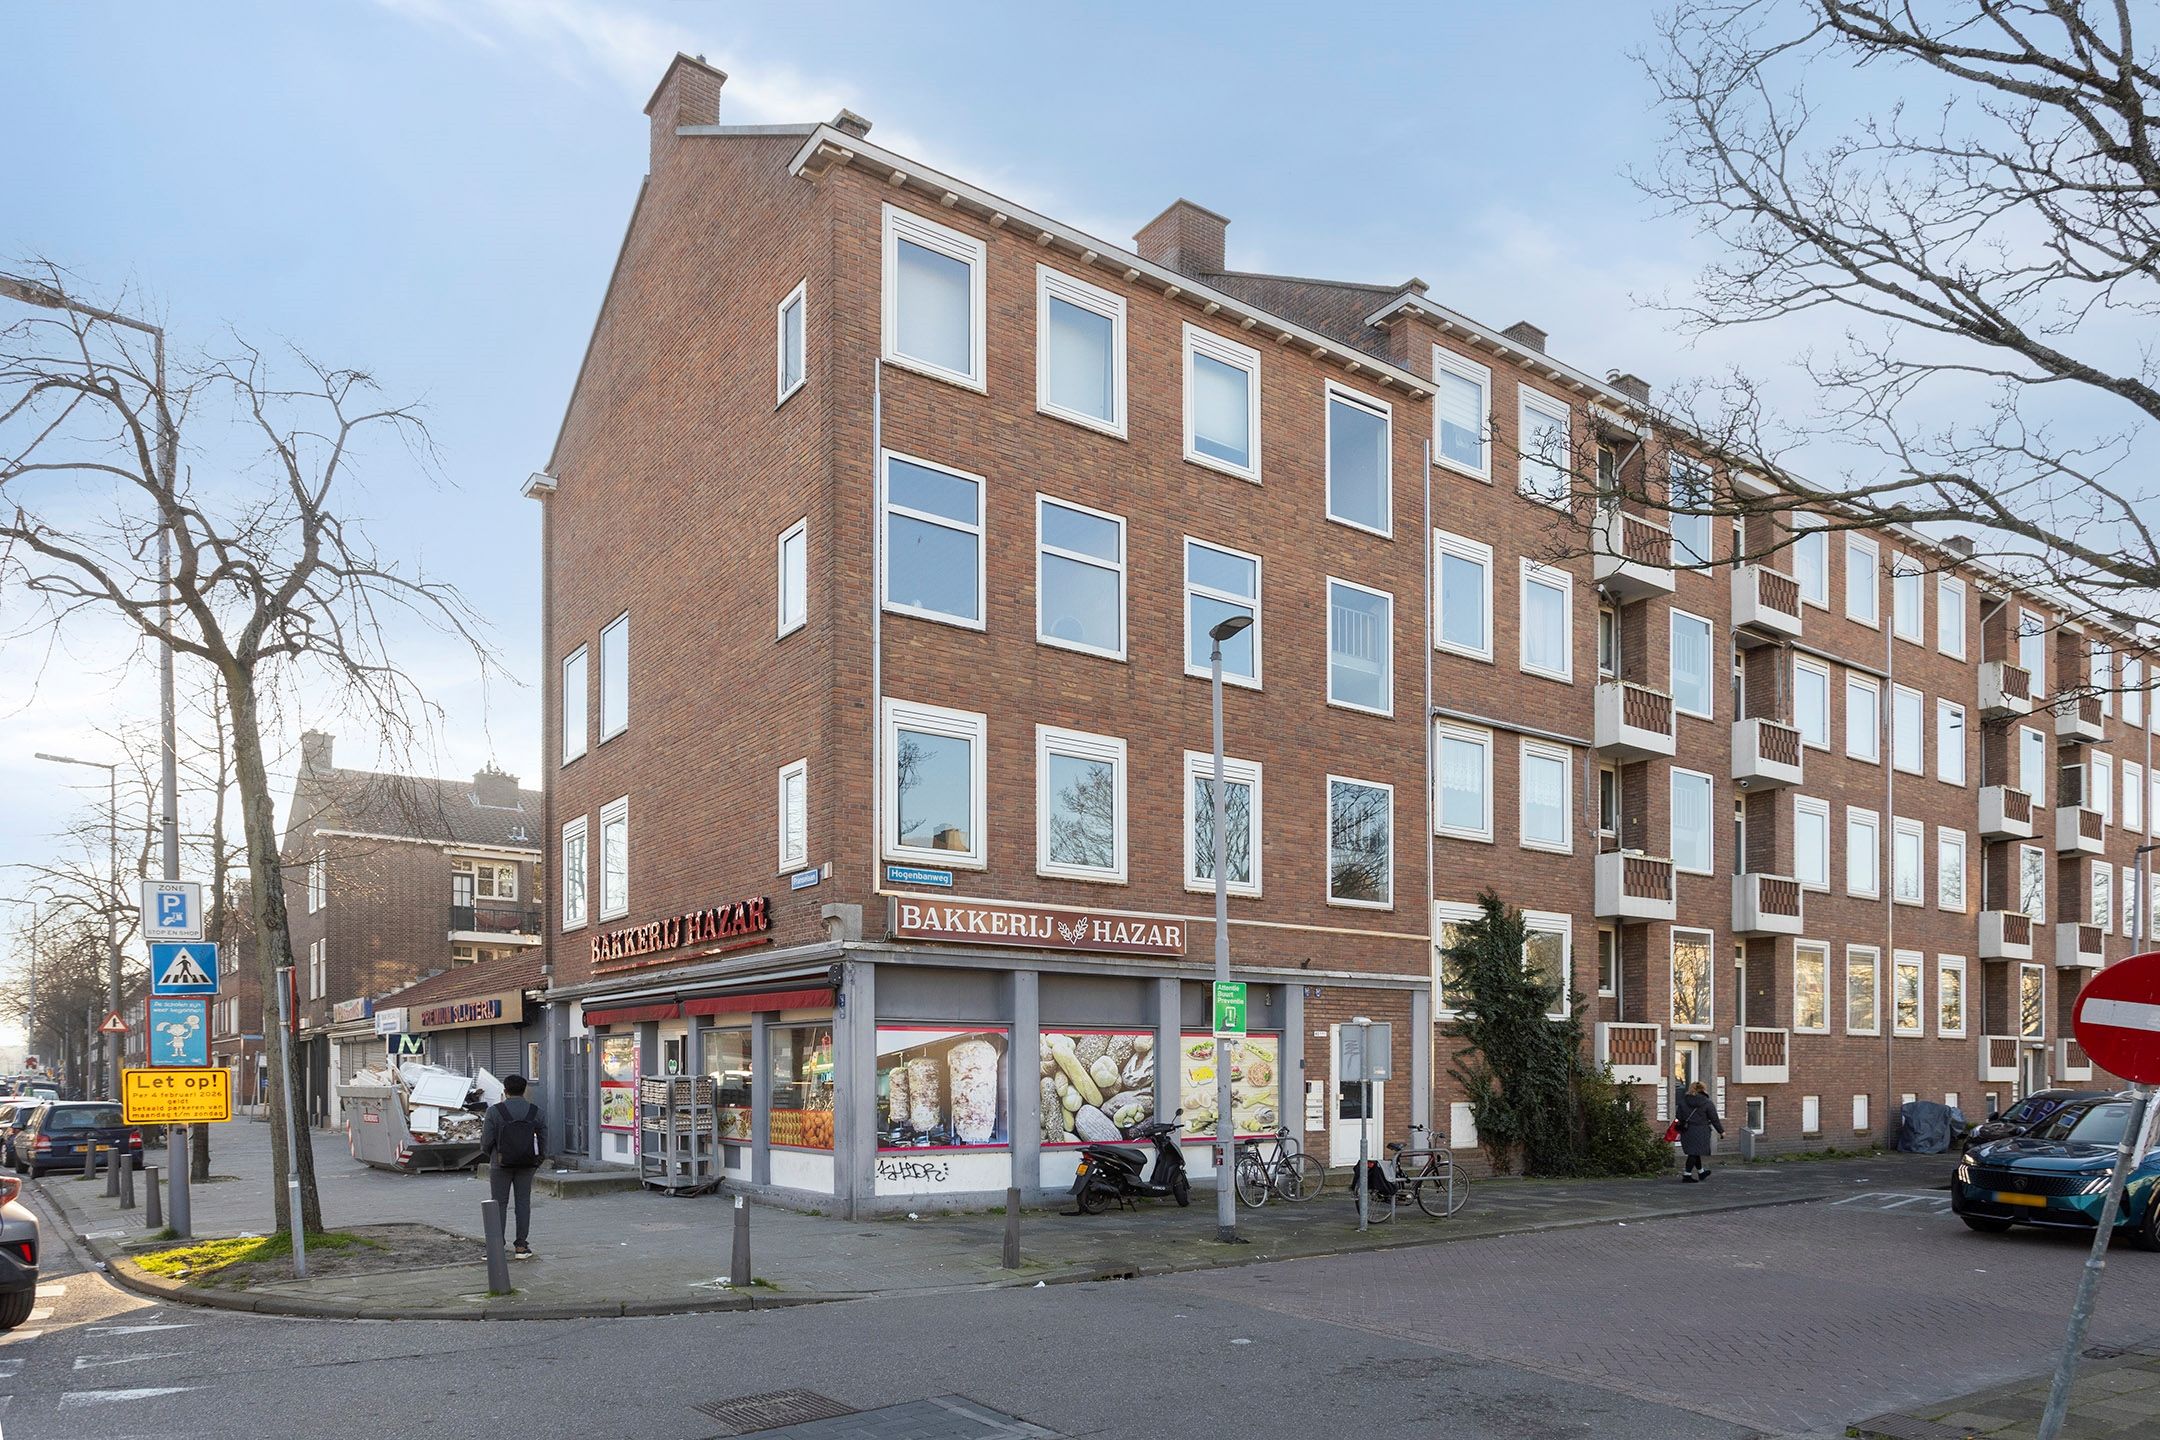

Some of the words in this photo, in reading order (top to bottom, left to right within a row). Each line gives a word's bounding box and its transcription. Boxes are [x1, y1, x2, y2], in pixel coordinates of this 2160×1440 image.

[892, 869, 948, 884] Hogenbanweg
[164, 895, 181, 913] P
[590, 917, 681, 964] BAKKERIJ
[685, 896, 768, 945] HAZAR
[901, 904, 1053, 939] BAKKERIJ
[1092, 919, 1182, 948] HAZAR
[453, 1000, 496, 1023] SLIJTERIJ
[137, 1075, 174, 1088] Let
[185, 1074, 217, 1090] op!
